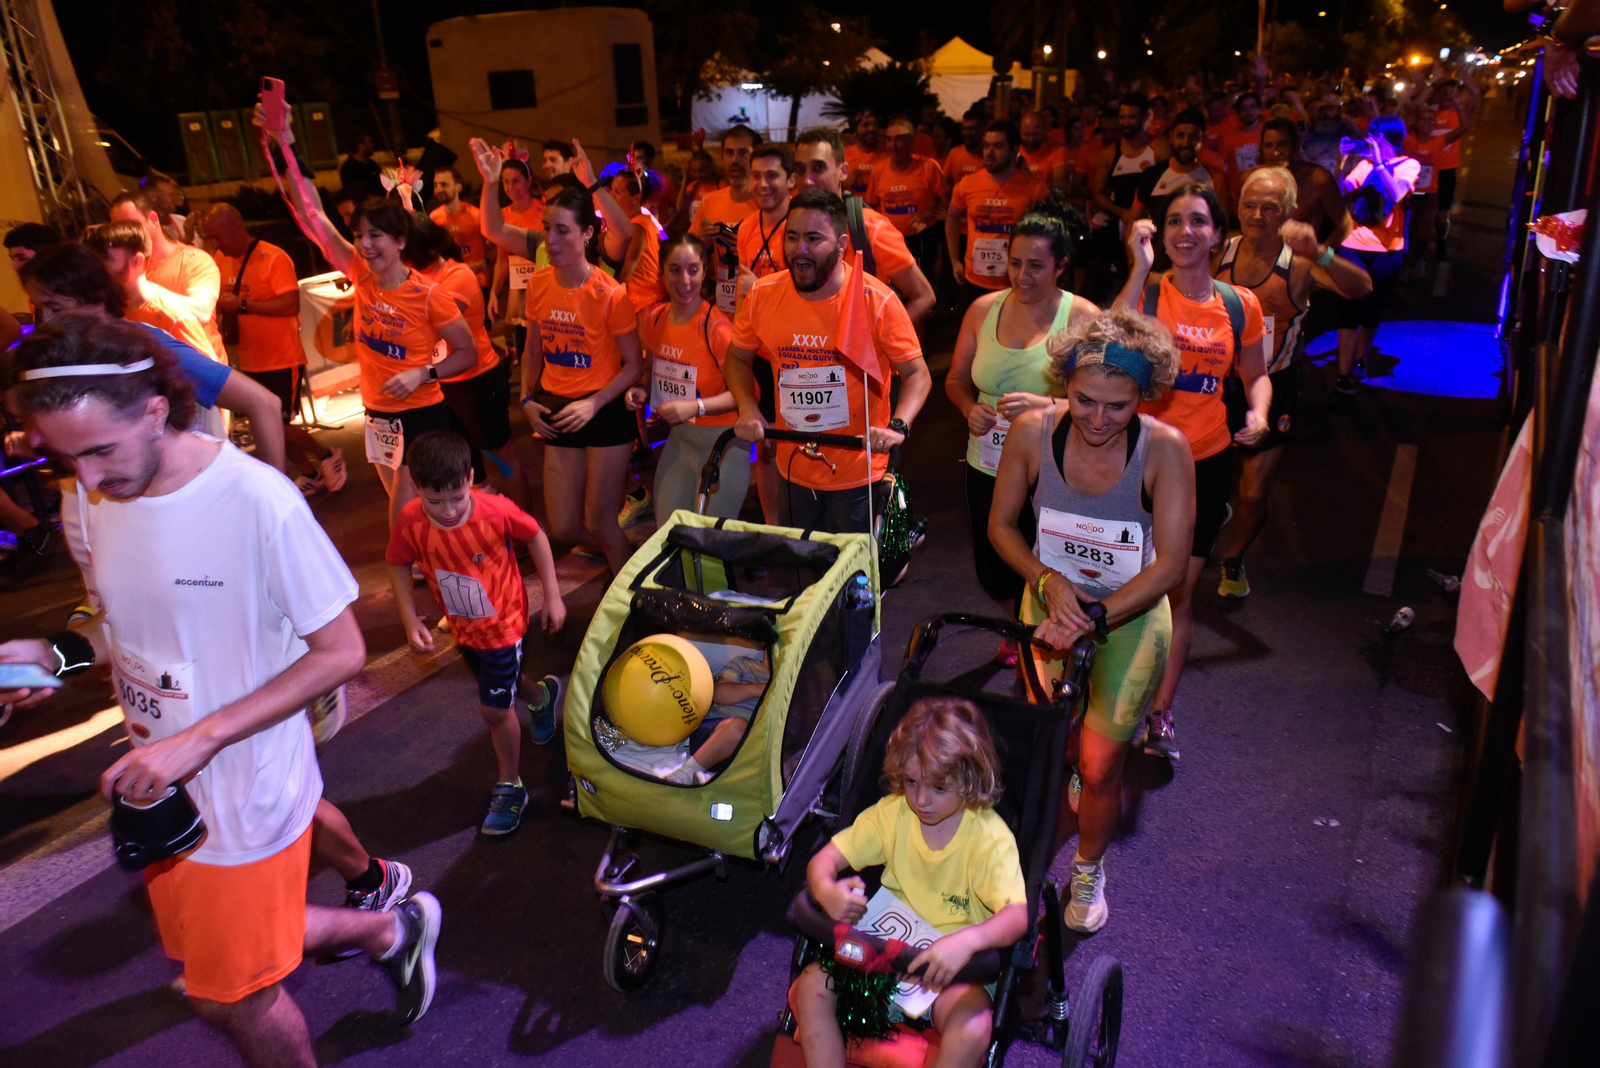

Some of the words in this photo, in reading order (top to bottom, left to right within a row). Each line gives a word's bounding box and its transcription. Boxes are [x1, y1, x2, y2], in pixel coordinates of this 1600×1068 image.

[981, 252, 1002, 260] 9175
[721, 284, 736, 295] 107
[550, 309, 577, 322] XXXV
[1176, 322, 1214, 340] XXXV
[792, 333, 828, 348] XXXV
[660, 344, 684, 359] XXXV
[657, 379, 687, 397] 15383
[790, 390, 833, 405] 11907
[1064, 541, 1115, 566] 8283
[174, 578, 224, 587] accenture
[440, 574, 486, 617] 17
[630, 646, 682, 685] Pravia
[672, 689, 698, 726] Heno
